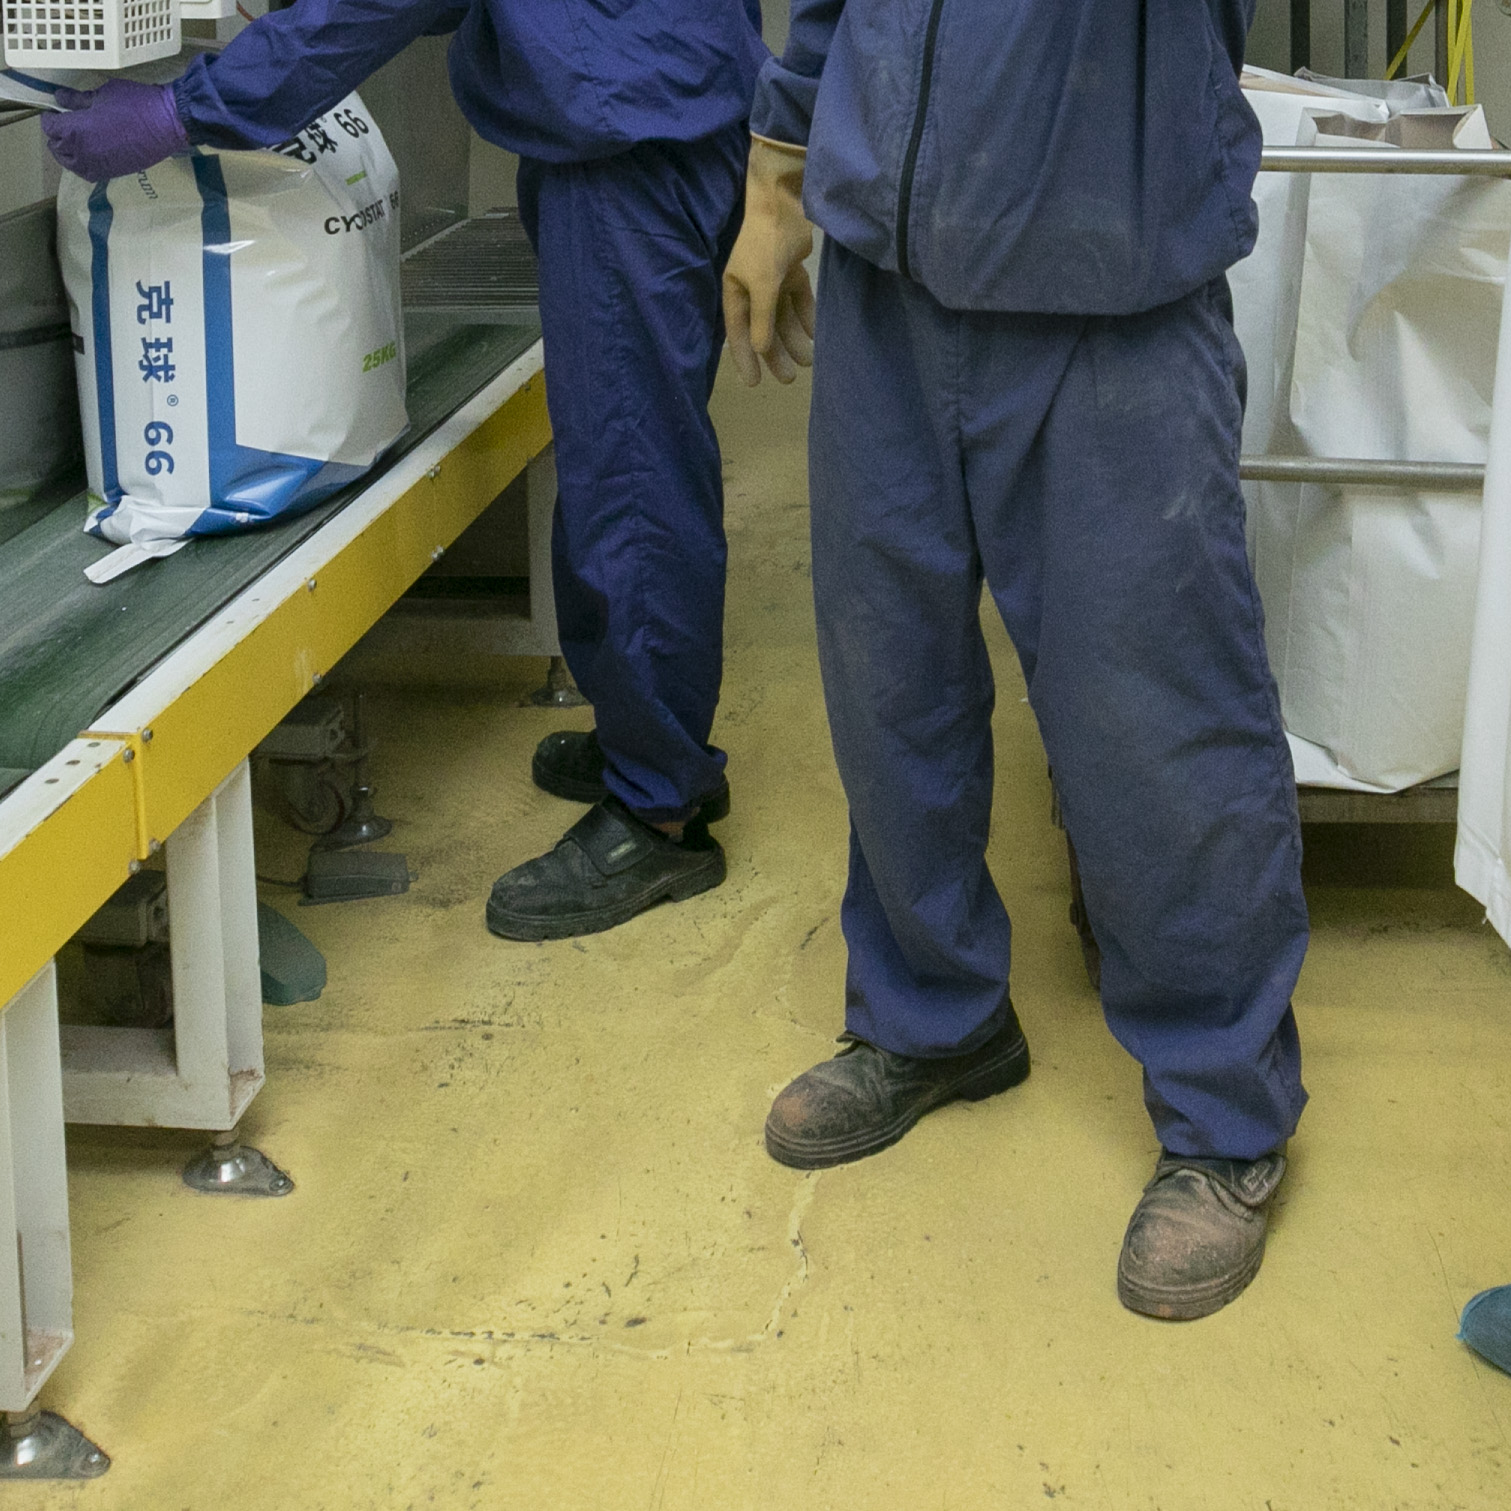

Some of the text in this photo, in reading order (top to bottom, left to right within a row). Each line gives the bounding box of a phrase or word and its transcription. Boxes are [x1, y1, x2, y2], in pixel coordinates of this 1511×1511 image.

[333, 109, 369, 138] 66
[362, 341, 396, 373] 25KG
[144, 420, 175, 476] 66
